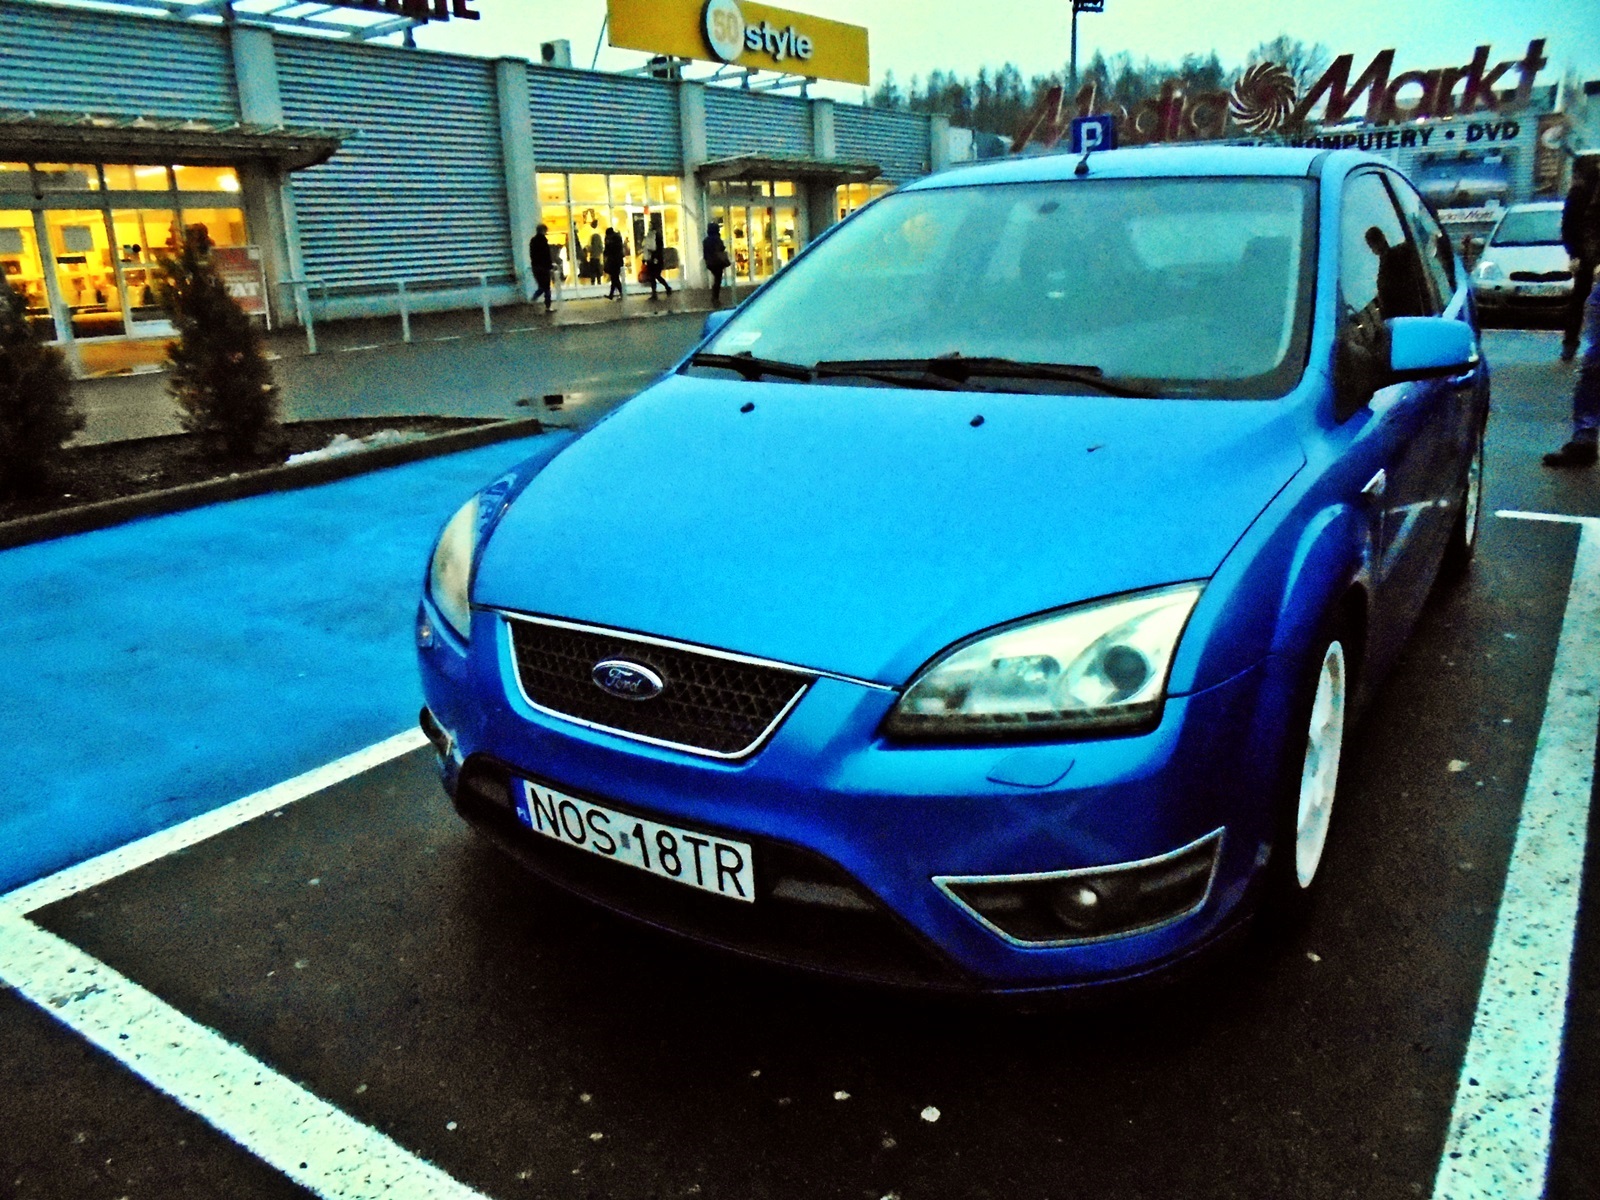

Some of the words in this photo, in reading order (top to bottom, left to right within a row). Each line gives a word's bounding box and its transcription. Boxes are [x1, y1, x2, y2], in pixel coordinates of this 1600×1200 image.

[744, 21, 814, 62] style
[1277, 38, 1548, 132] Markt
[1080, 121, 1103, 154] P
[1465, 121, 1520, 143] DVD
[605, 667, 643, 693] Ford
[530, 787, 617, 856] NOS
[632, 822, 747, 897] 18TR
